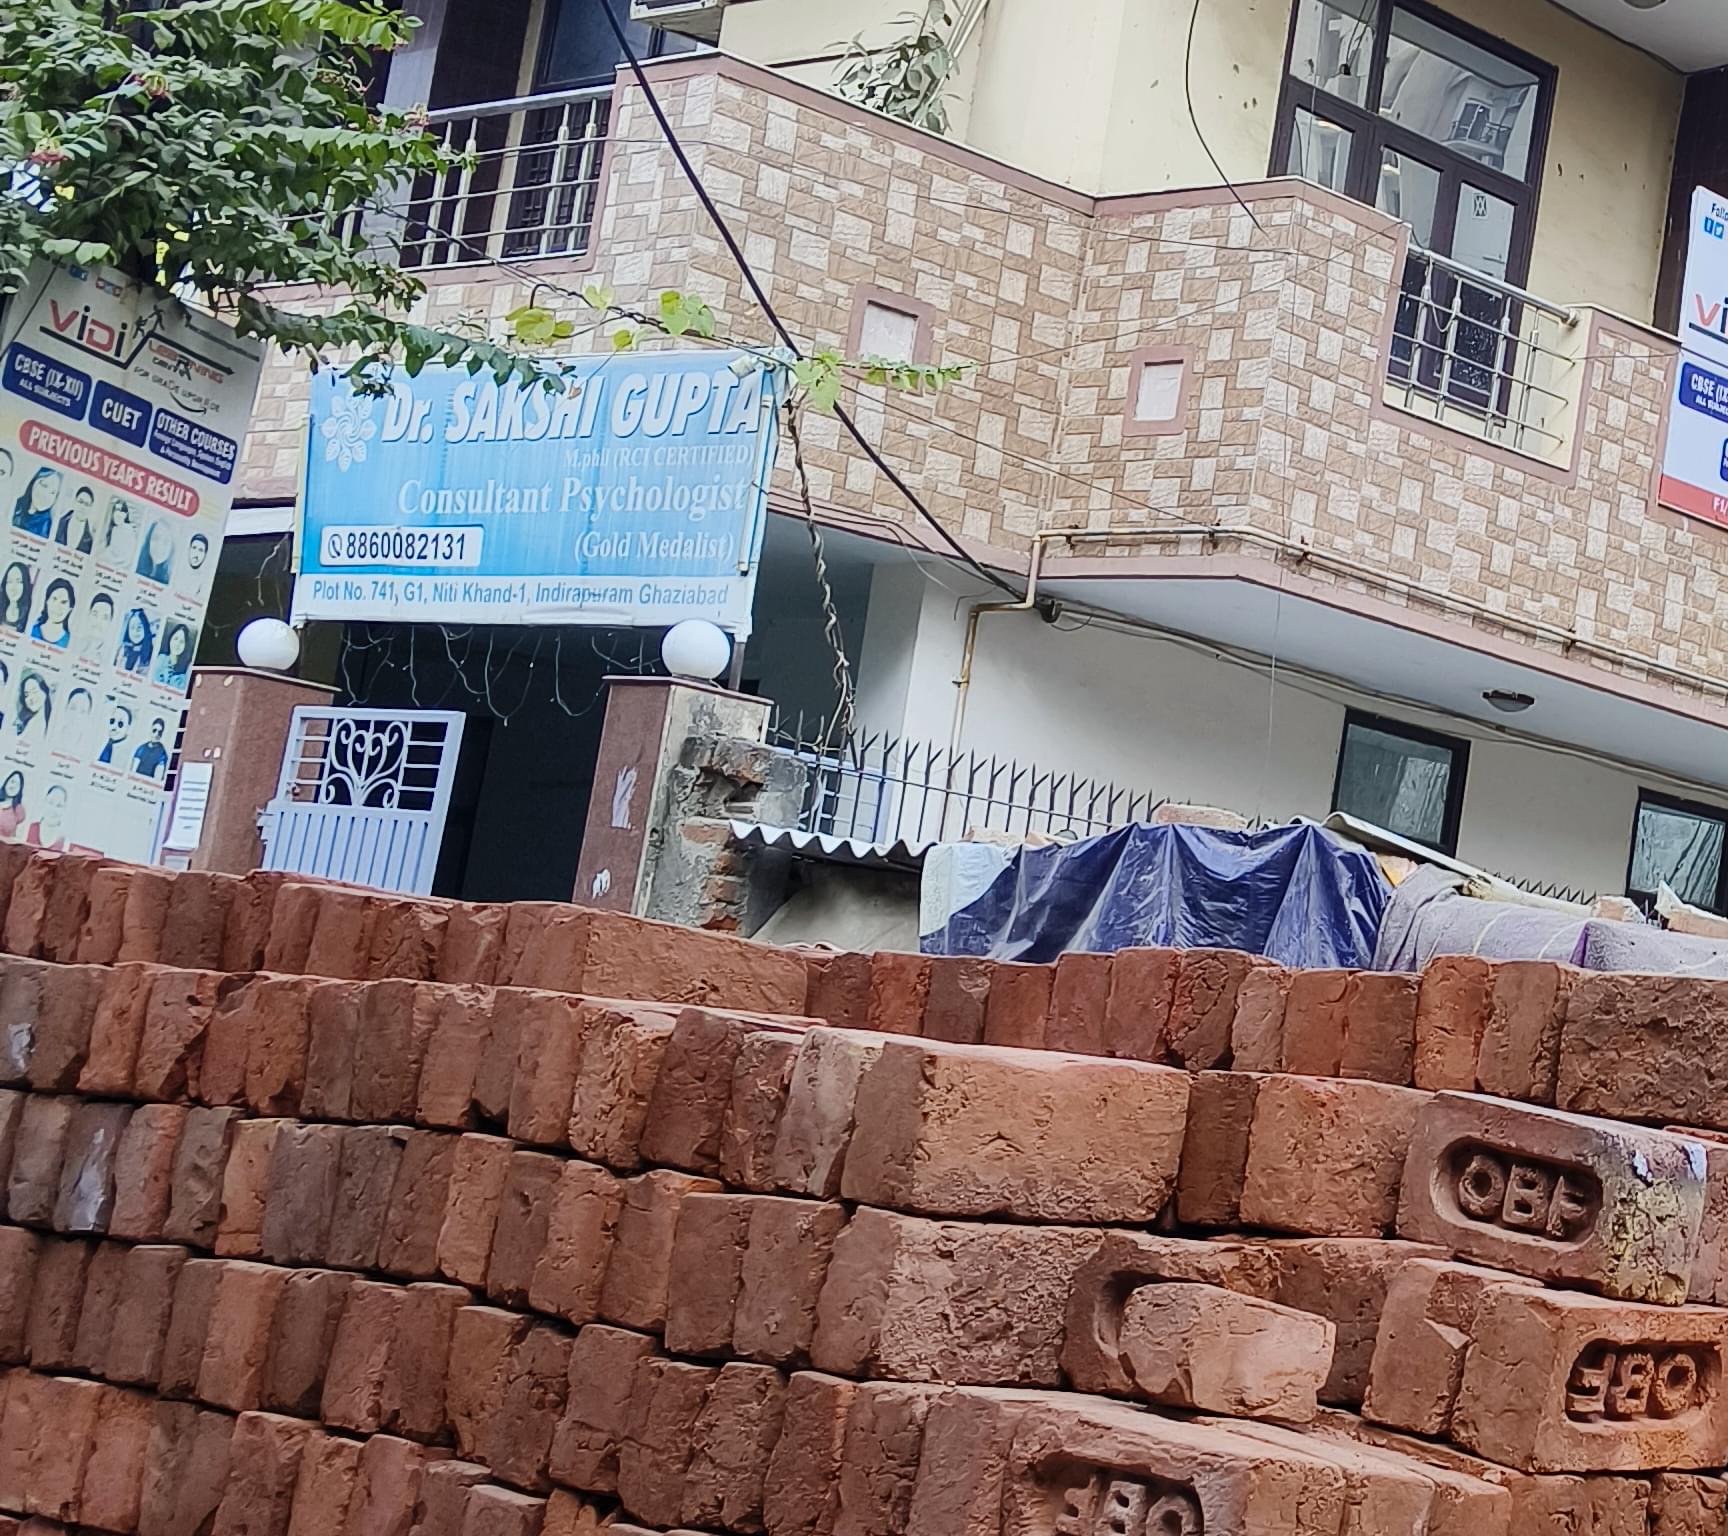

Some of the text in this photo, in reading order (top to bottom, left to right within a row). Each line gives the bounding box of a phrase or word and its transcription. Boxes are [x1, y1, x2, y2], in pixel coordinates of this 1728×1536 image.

[15, 354, 45, 380] CBSE
[1691, 373, 1715, 394] CBSE
[101, 399, 142, 430] CUET
[382, 369, 765, 444] Dr. SAKSHI GUPTA
[157, 412, 190, 440] OTHER
[191, 428, 235, 460] COURSES
[29, 427, 101, 472] PREVIOUS
[148, 475, 193, 510] RESULT
[651, 444, 755, 467] CERTIFIED)
[398, 475, 748, 521] Consultant Psychologist
[346, 532, 466, 562] 8860082131
[574, 530, 735, 564] (Gold Medalist)
[312, 580, 728, 608] Plot No. 741, G1, Niti Khand-1, Indirapuram Ghaziabad
